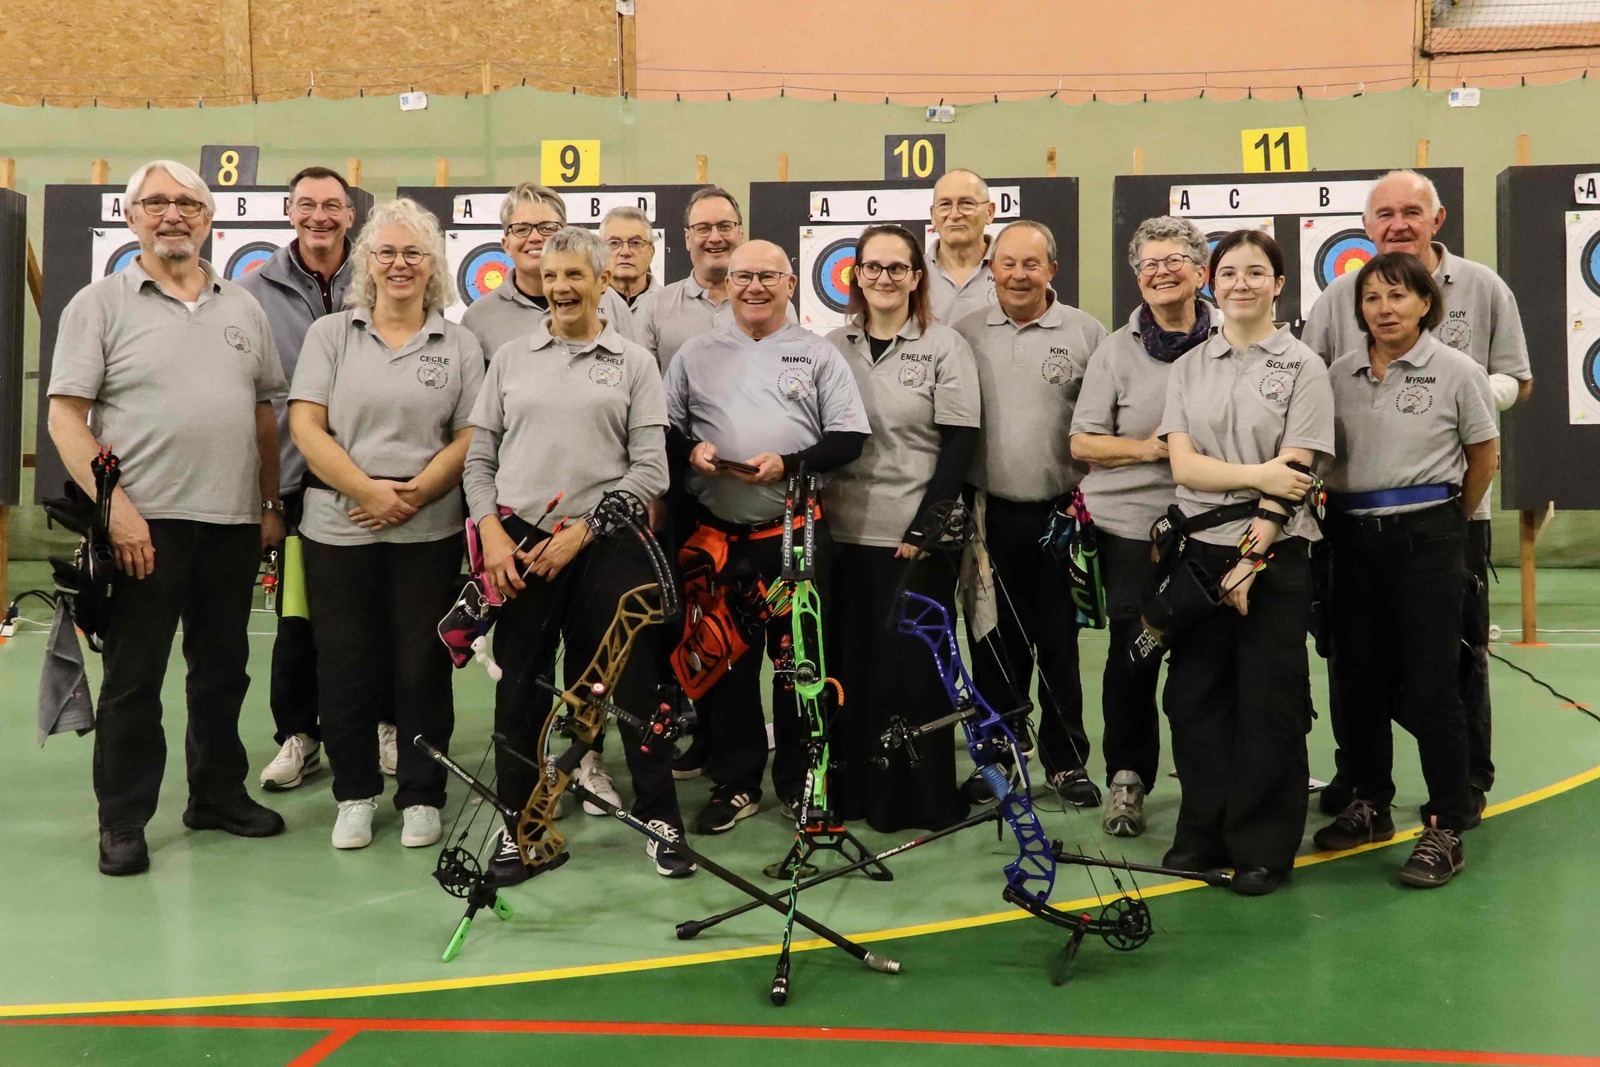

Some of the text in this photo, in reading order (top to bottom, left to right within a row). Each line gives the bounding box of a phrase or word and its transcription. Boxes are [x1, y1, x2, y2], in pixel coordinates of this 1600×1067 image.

[894, 139, 934, 178] 10
[1254, 132, 1290, 171] 11
[217, 151, 239, 186] 8
[560, 145, 581, 183] 9
[1586, 178, 1597, 198] A
[112, 197, 246, 216] A B
[463, 197, 647, 218] A B D
[820, 193, 1011, 217] A C D
[1180, 187, 1330, 210] A C B
[420, 355, 450, 366] CECILE
[595, 353, 625, 365] MICHELE
[781, 356, 812, 365] MINOU
[900, 353, 933, 362] EMELINE
[1050, 347, 1068, 356] KIKI
[1266, 359, 1300, 370] SOLINE
[1404, 376, 1436, 384] MYRIAM
[786, 498, 793, 507] X
[808, 497, 814, 506] X
[784, 508, 792, 567] CONCEPT
